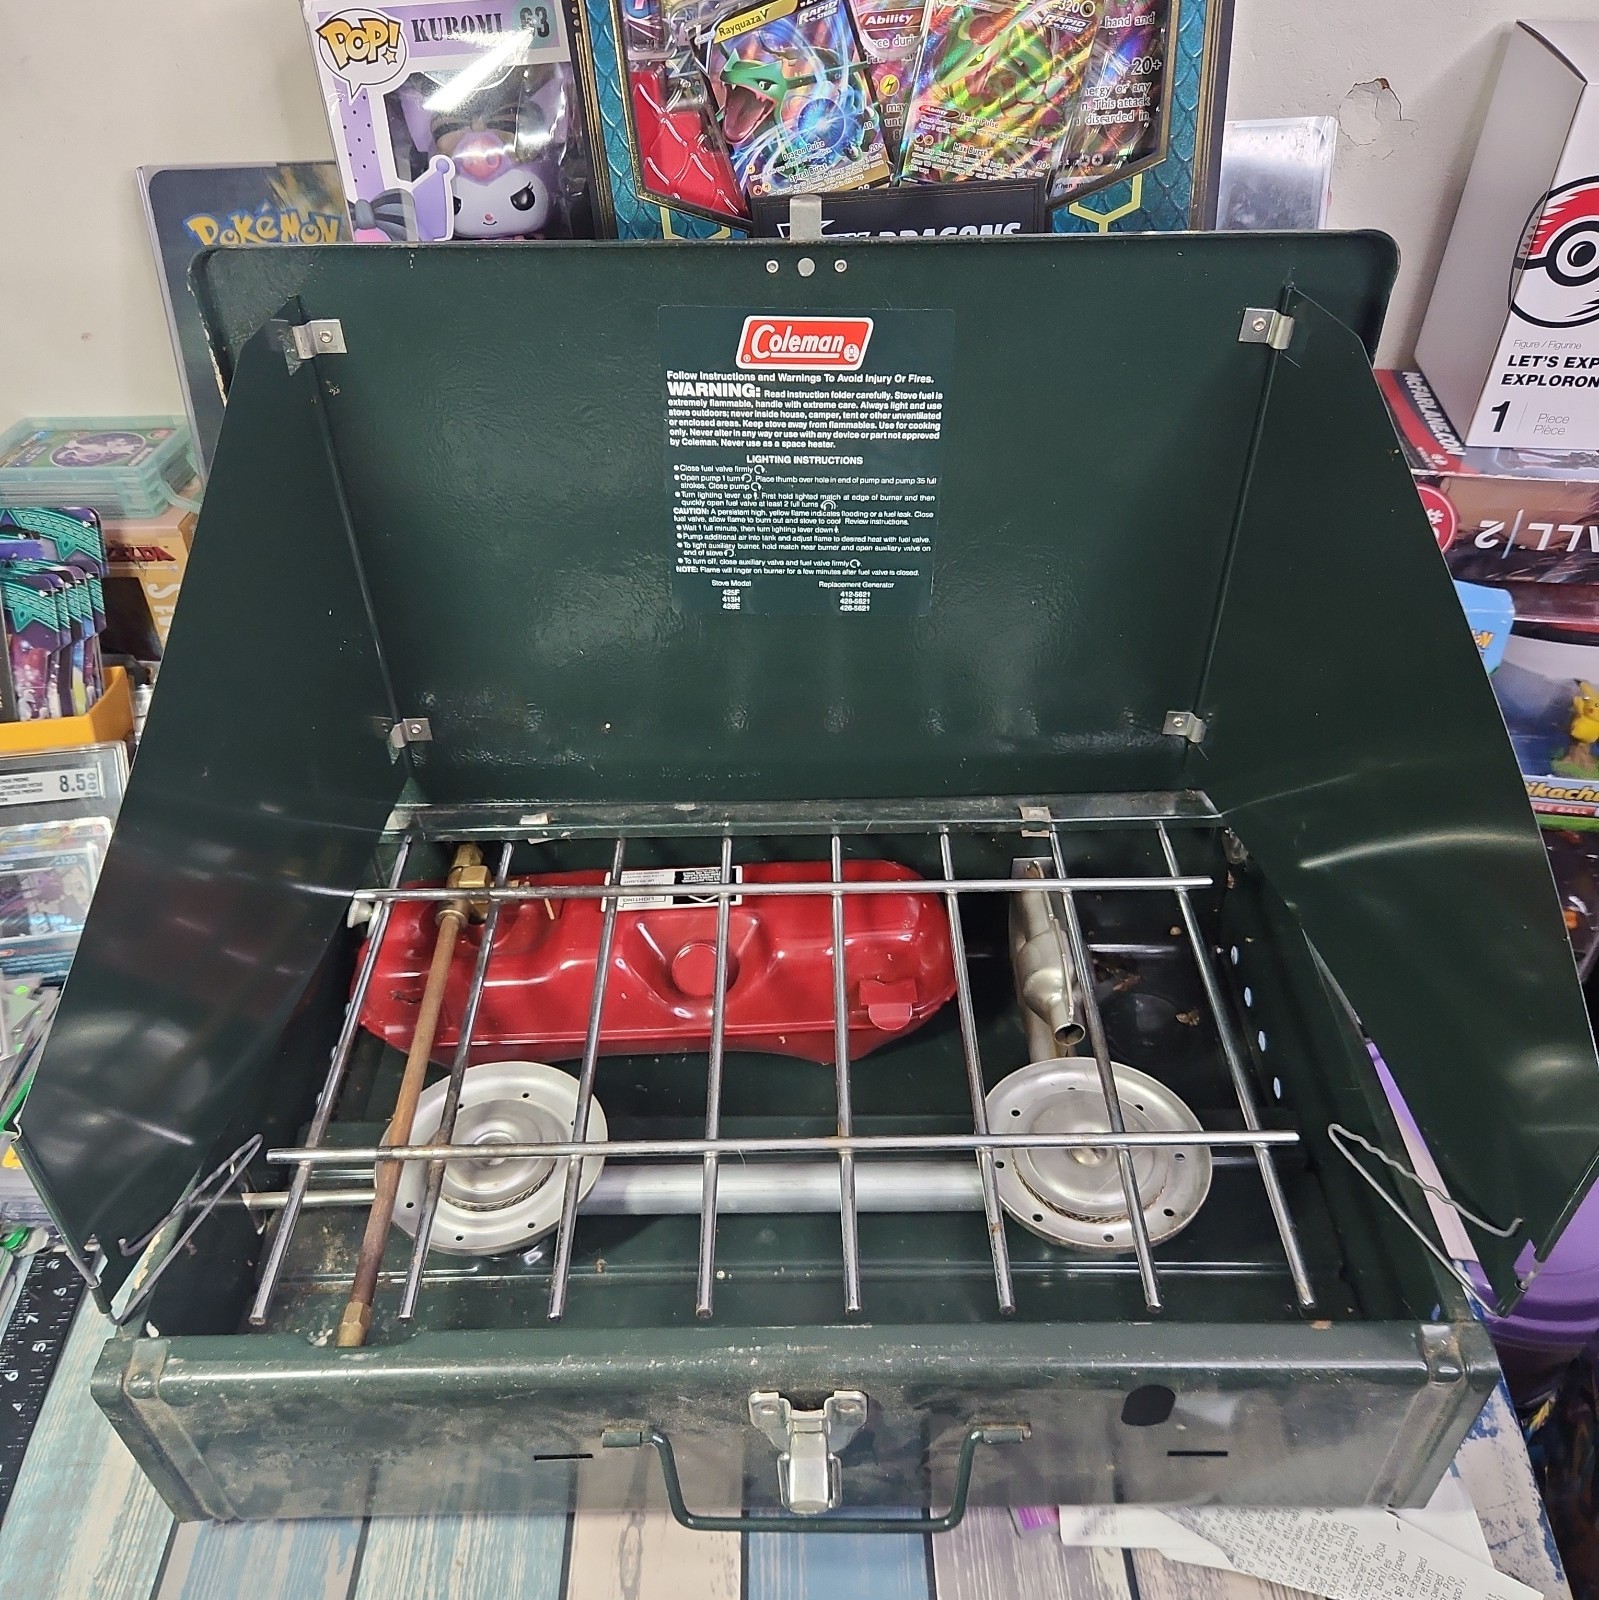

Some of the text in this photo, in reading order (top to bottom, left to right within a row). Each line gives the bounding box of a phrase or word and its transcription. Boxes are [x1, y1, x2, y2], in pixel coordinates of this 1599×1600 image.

[799, 1, 838, 25] RAPID
[865, 14, 914, 25] Ability
[1042, 14, 1087, 27] RAPID
[1105, 13, 1155, 28] hand and
[412, 13, 502, 42] KUROMI
[317, 18, 401, 68] POP!
[1131, 57, 1162, 75] 20+
[1115, 85, 1128, 94] or
[1133, 82, 1152, 96] any
[1095, 96, 1151, 110] This attack
[1086, 110, 1150, 125] discarded in
[751, 323, 845, 360] Coleman
[1513, 340, 1540, 350] Figure
[1547, 340, 1581, 350] Figurine
[1507, 355, 1559, 368] LET'S
[666, 371, 934, 385] Follow Instructions and Warnings To Avoid Injury Or Fires.
[666, 382, 943, 401] WARNING: Read instruction folder carefully. Stove fuel is
[668, 399, 708, 408] extremely
[709, 399, 753, 409] flammable,
[803, 400, 836, 408] extreme
[860, 401, 889, 411] Always
[890, 401, 908, 411] light
[910, 401, 925, 409] and
[691, 409, 729, 419] outdoors;
[780, 410, 807, 420] house,
[808, 412, 841, 420] camper,
[870, 411, 890, 419] other
[892, 411, 941, 419] unventilated
[1491, 401, 1511, 432] 1
[1537, 413, 1570, 424] Piece
[743, 419, 763, 429] Keep
[788, 421, 807, 430] away
[809, 420, 827, 428] from
[829, 420, 877, 428] flammables.
[896, 421, 907, 429] for
[908, 421, 941, 431] cooking
[1533, 424, 1566, 436] Pièce
[669, 428, 688, 438] only.
[733, 429, 740, 437] in
[742, 431, 756, 439] any
[758, 431, 773, 439] way
[817, 432, 832, 440] any
[833, 430, 859, 438] device
[870, 431, 887, 440] part
[902, 431, 940, 441] approved
[669, 438, 680, 448] by
[681, 438, 719, 446] Coleman.
[782, 441, 806, 450] space
[808, 440, 836, 448] heater.
[746, 455, 864, 464] LIGHTING INSTRUCTIONS
[735, 465, 753, 474] firmly
[1474, 520, 1505, 549] 2
[59, 773, 86, 793] 8.5
[1526, 781, 1599, 803] ikach
[25, 1315, 39, 1324] 7
[32, 1341, 47, 1353] 5
[4, 1371, 19, 1382] 6
[1420, 1569, 1435, 1597] return
